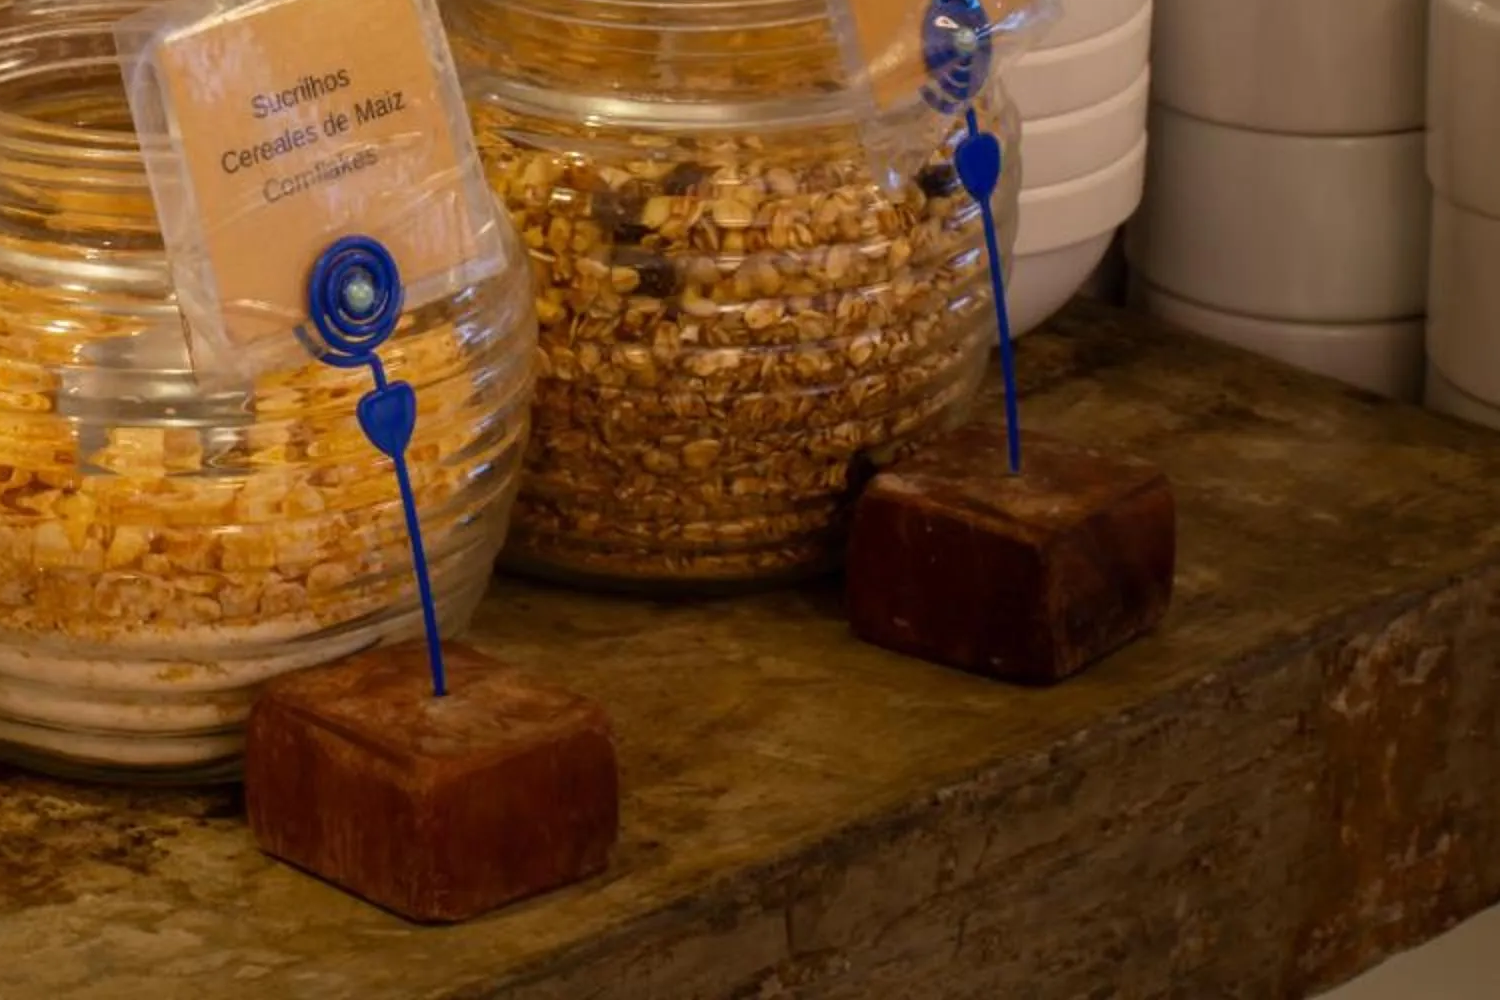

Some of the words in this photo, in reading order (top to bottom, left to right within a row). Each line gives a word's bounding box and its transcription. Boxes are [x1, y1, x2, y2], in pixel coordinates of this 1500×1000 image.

[252, 68, 350, 119] Sucrilhos
[221, 124, 319, 174] Cereales
[323, 112, 349, 138] de
